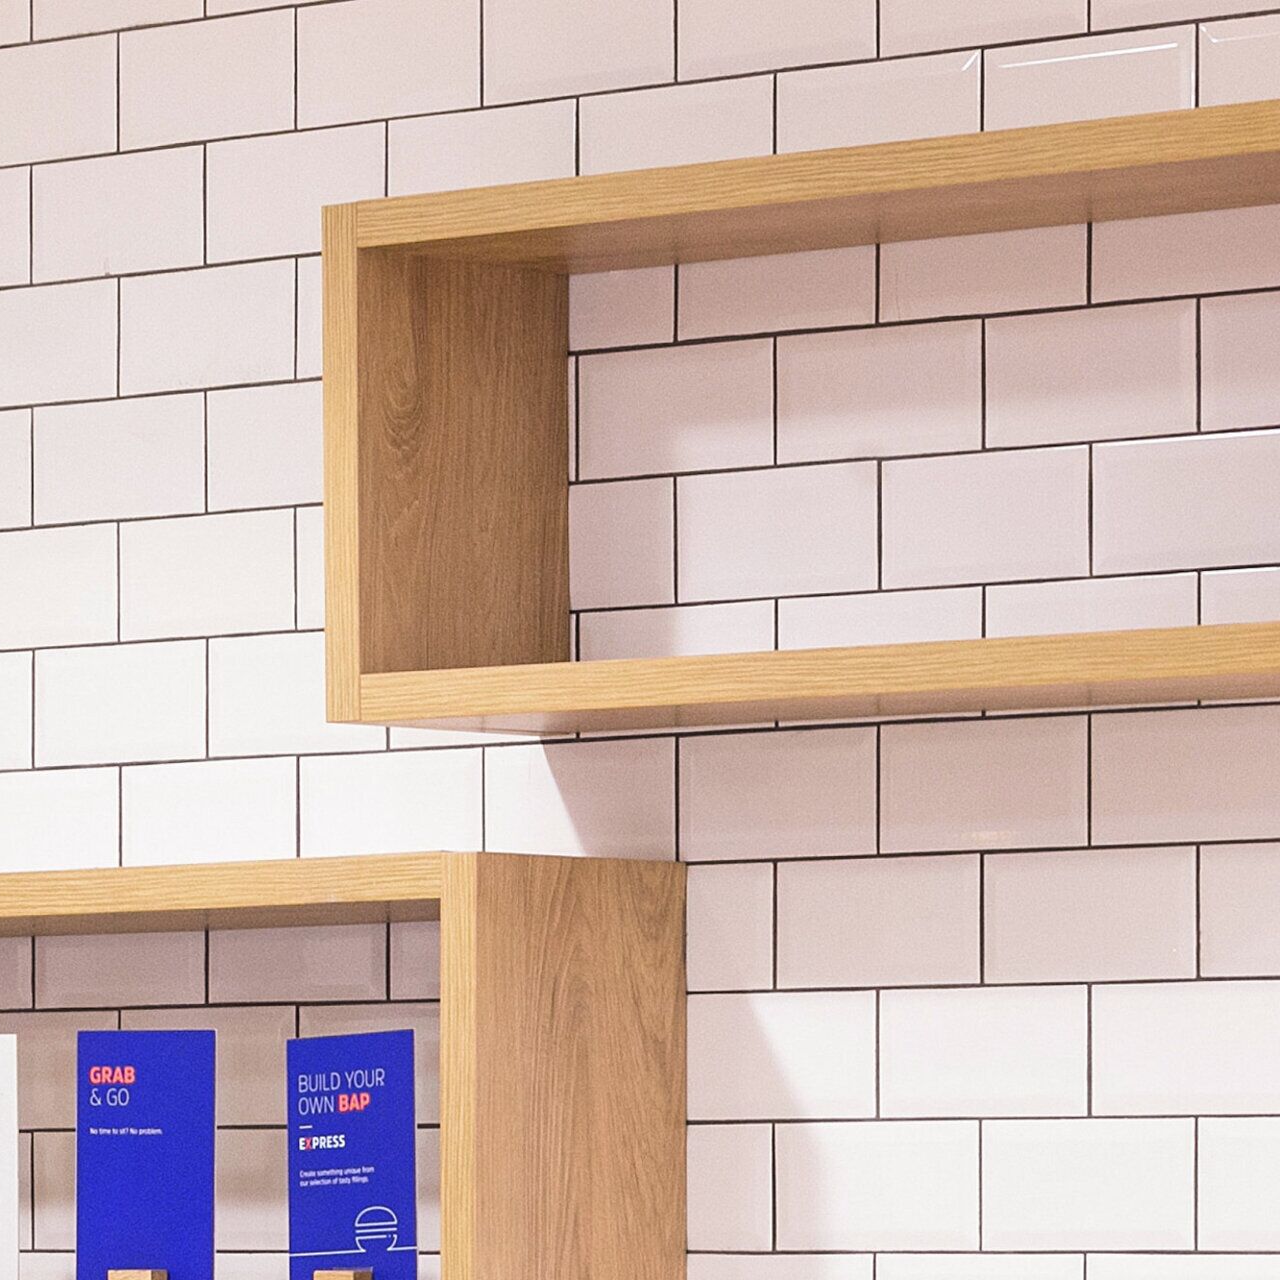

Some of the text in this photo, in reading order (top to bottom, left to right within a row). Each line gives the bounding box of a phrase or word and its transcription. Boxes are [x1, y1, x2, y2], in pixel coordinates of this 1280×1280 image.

[89, 1066, 136, 1084] GRAB
[298, 1068, 385, 1093] BUILD YOUR
[90, 1087, 130, 1106] & GO
[298, 1092, 370, 1116] OWN BAP
[299, 1134, 346, 1151] EXPRESS
